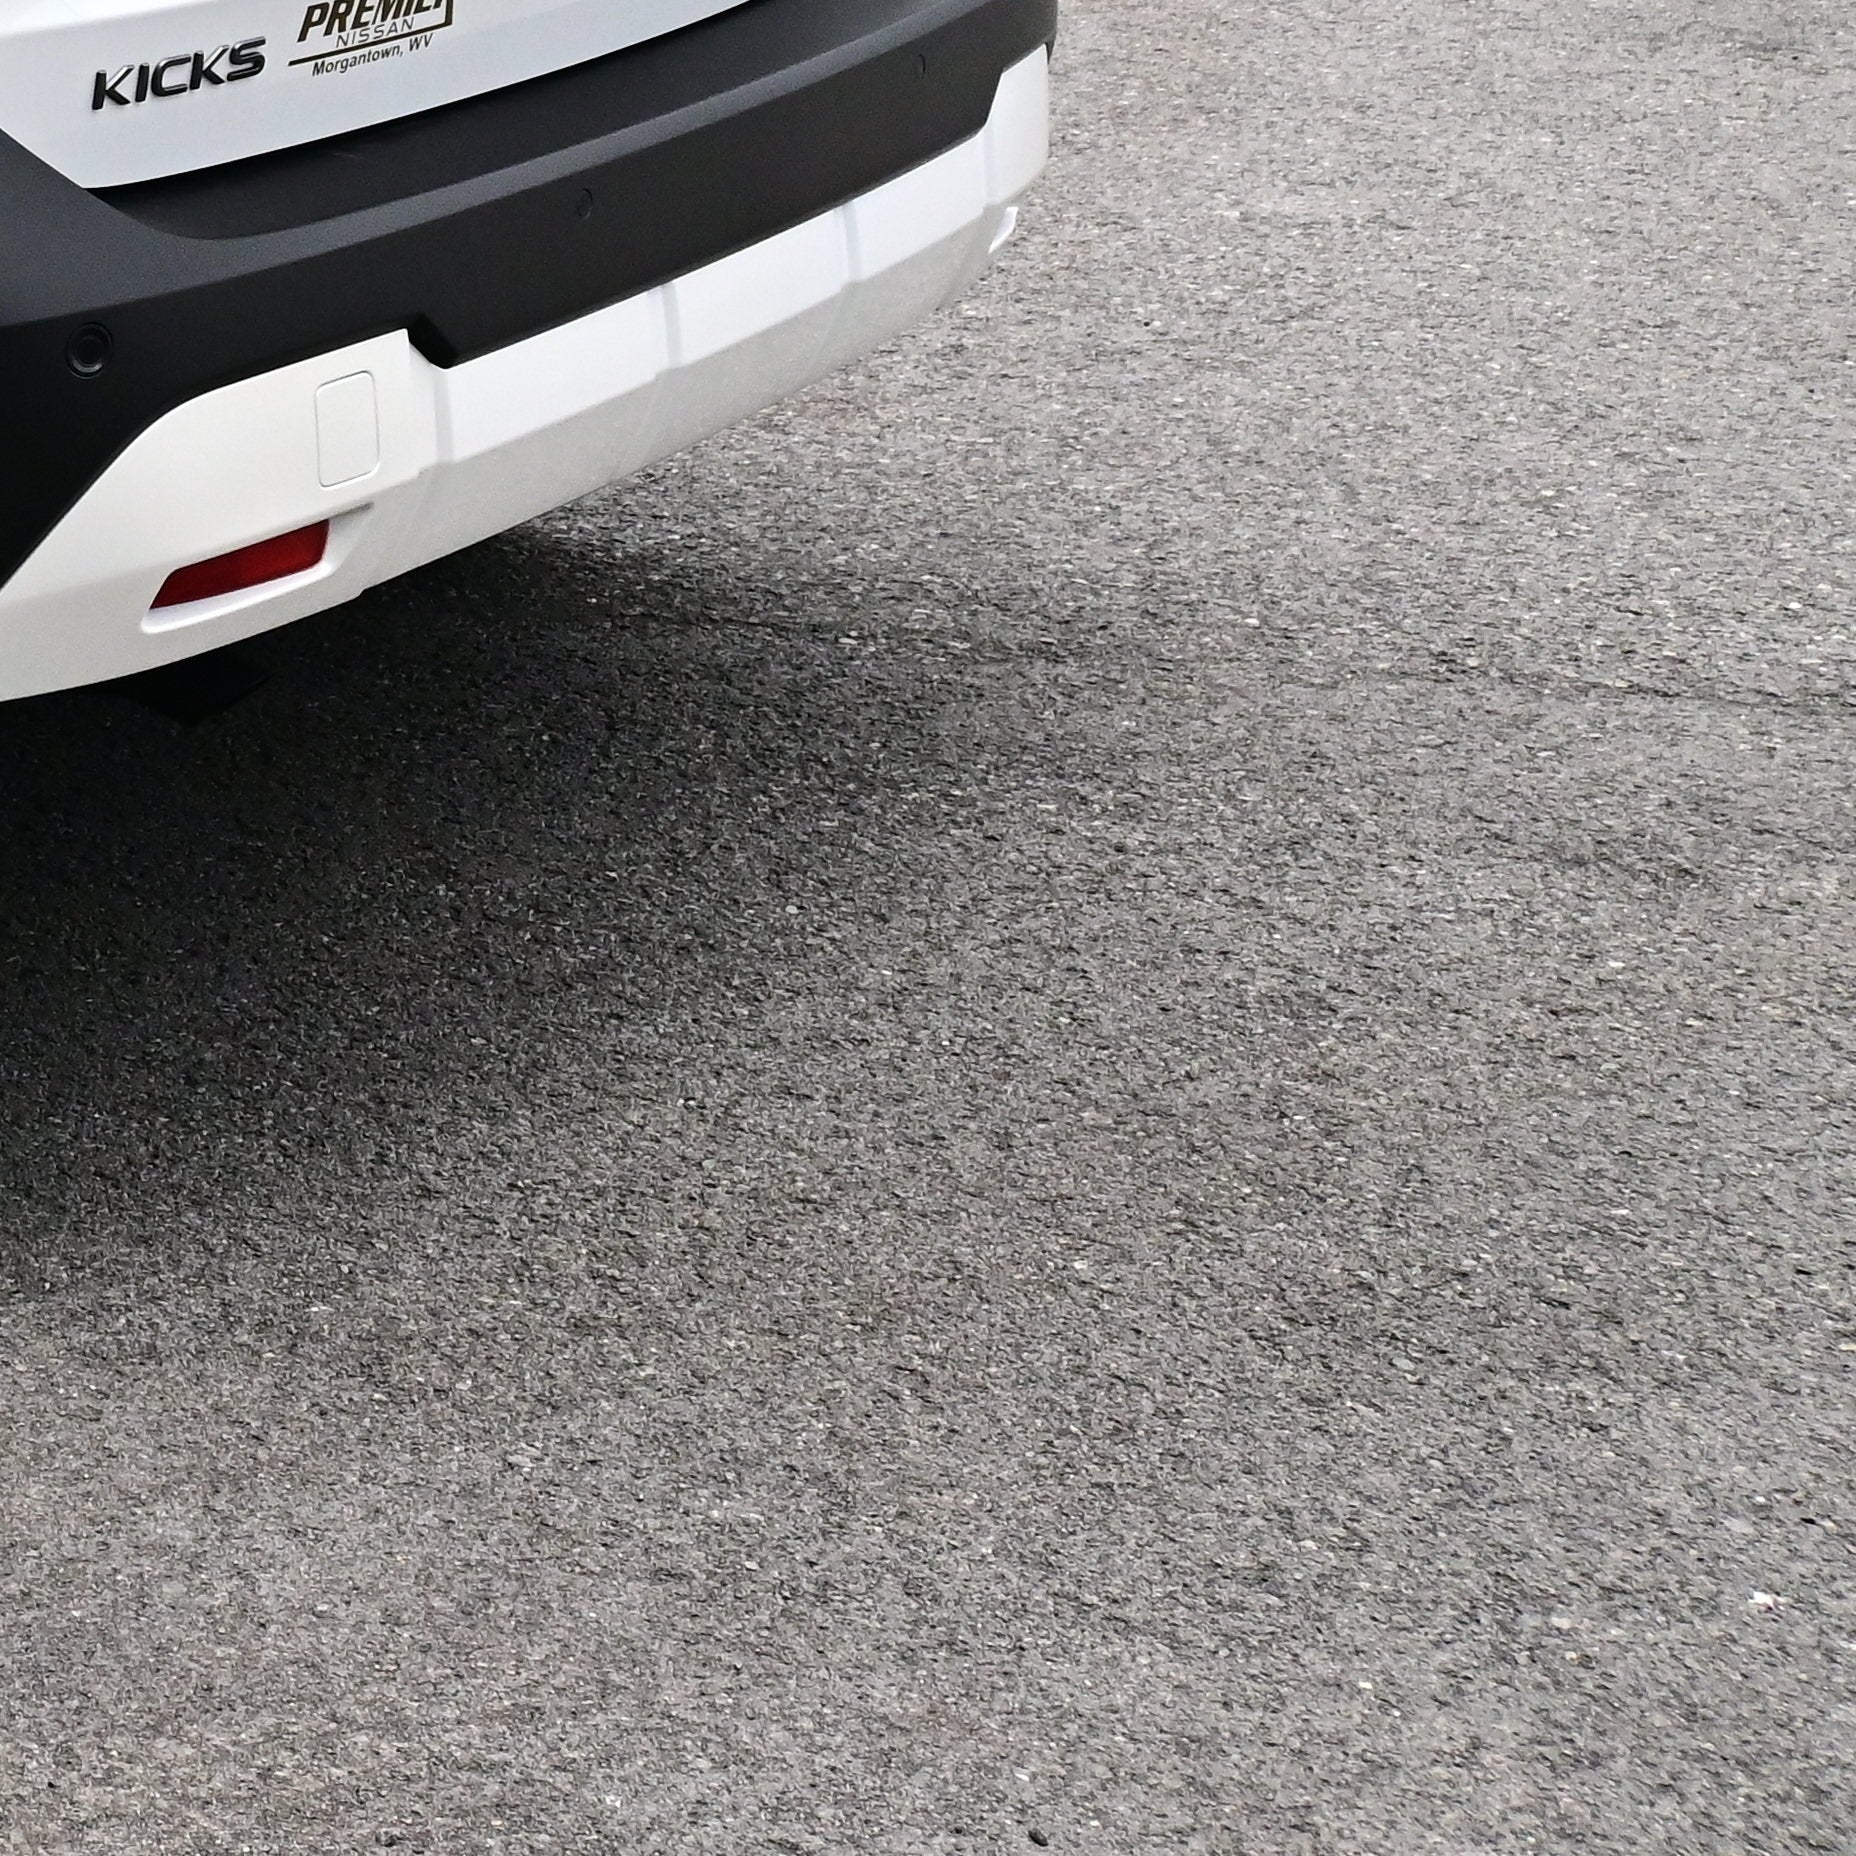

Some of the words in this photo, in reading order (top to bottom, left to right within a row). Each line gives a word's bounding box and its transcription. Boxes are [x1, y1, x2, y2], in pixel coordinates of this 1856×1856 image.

[311, 44, 404, 76] Morgantown,
[408, 32, 434, 53] WV
[335, 17, 415, 48] NISSAN
[90, 36, 267, 111] KICKS
